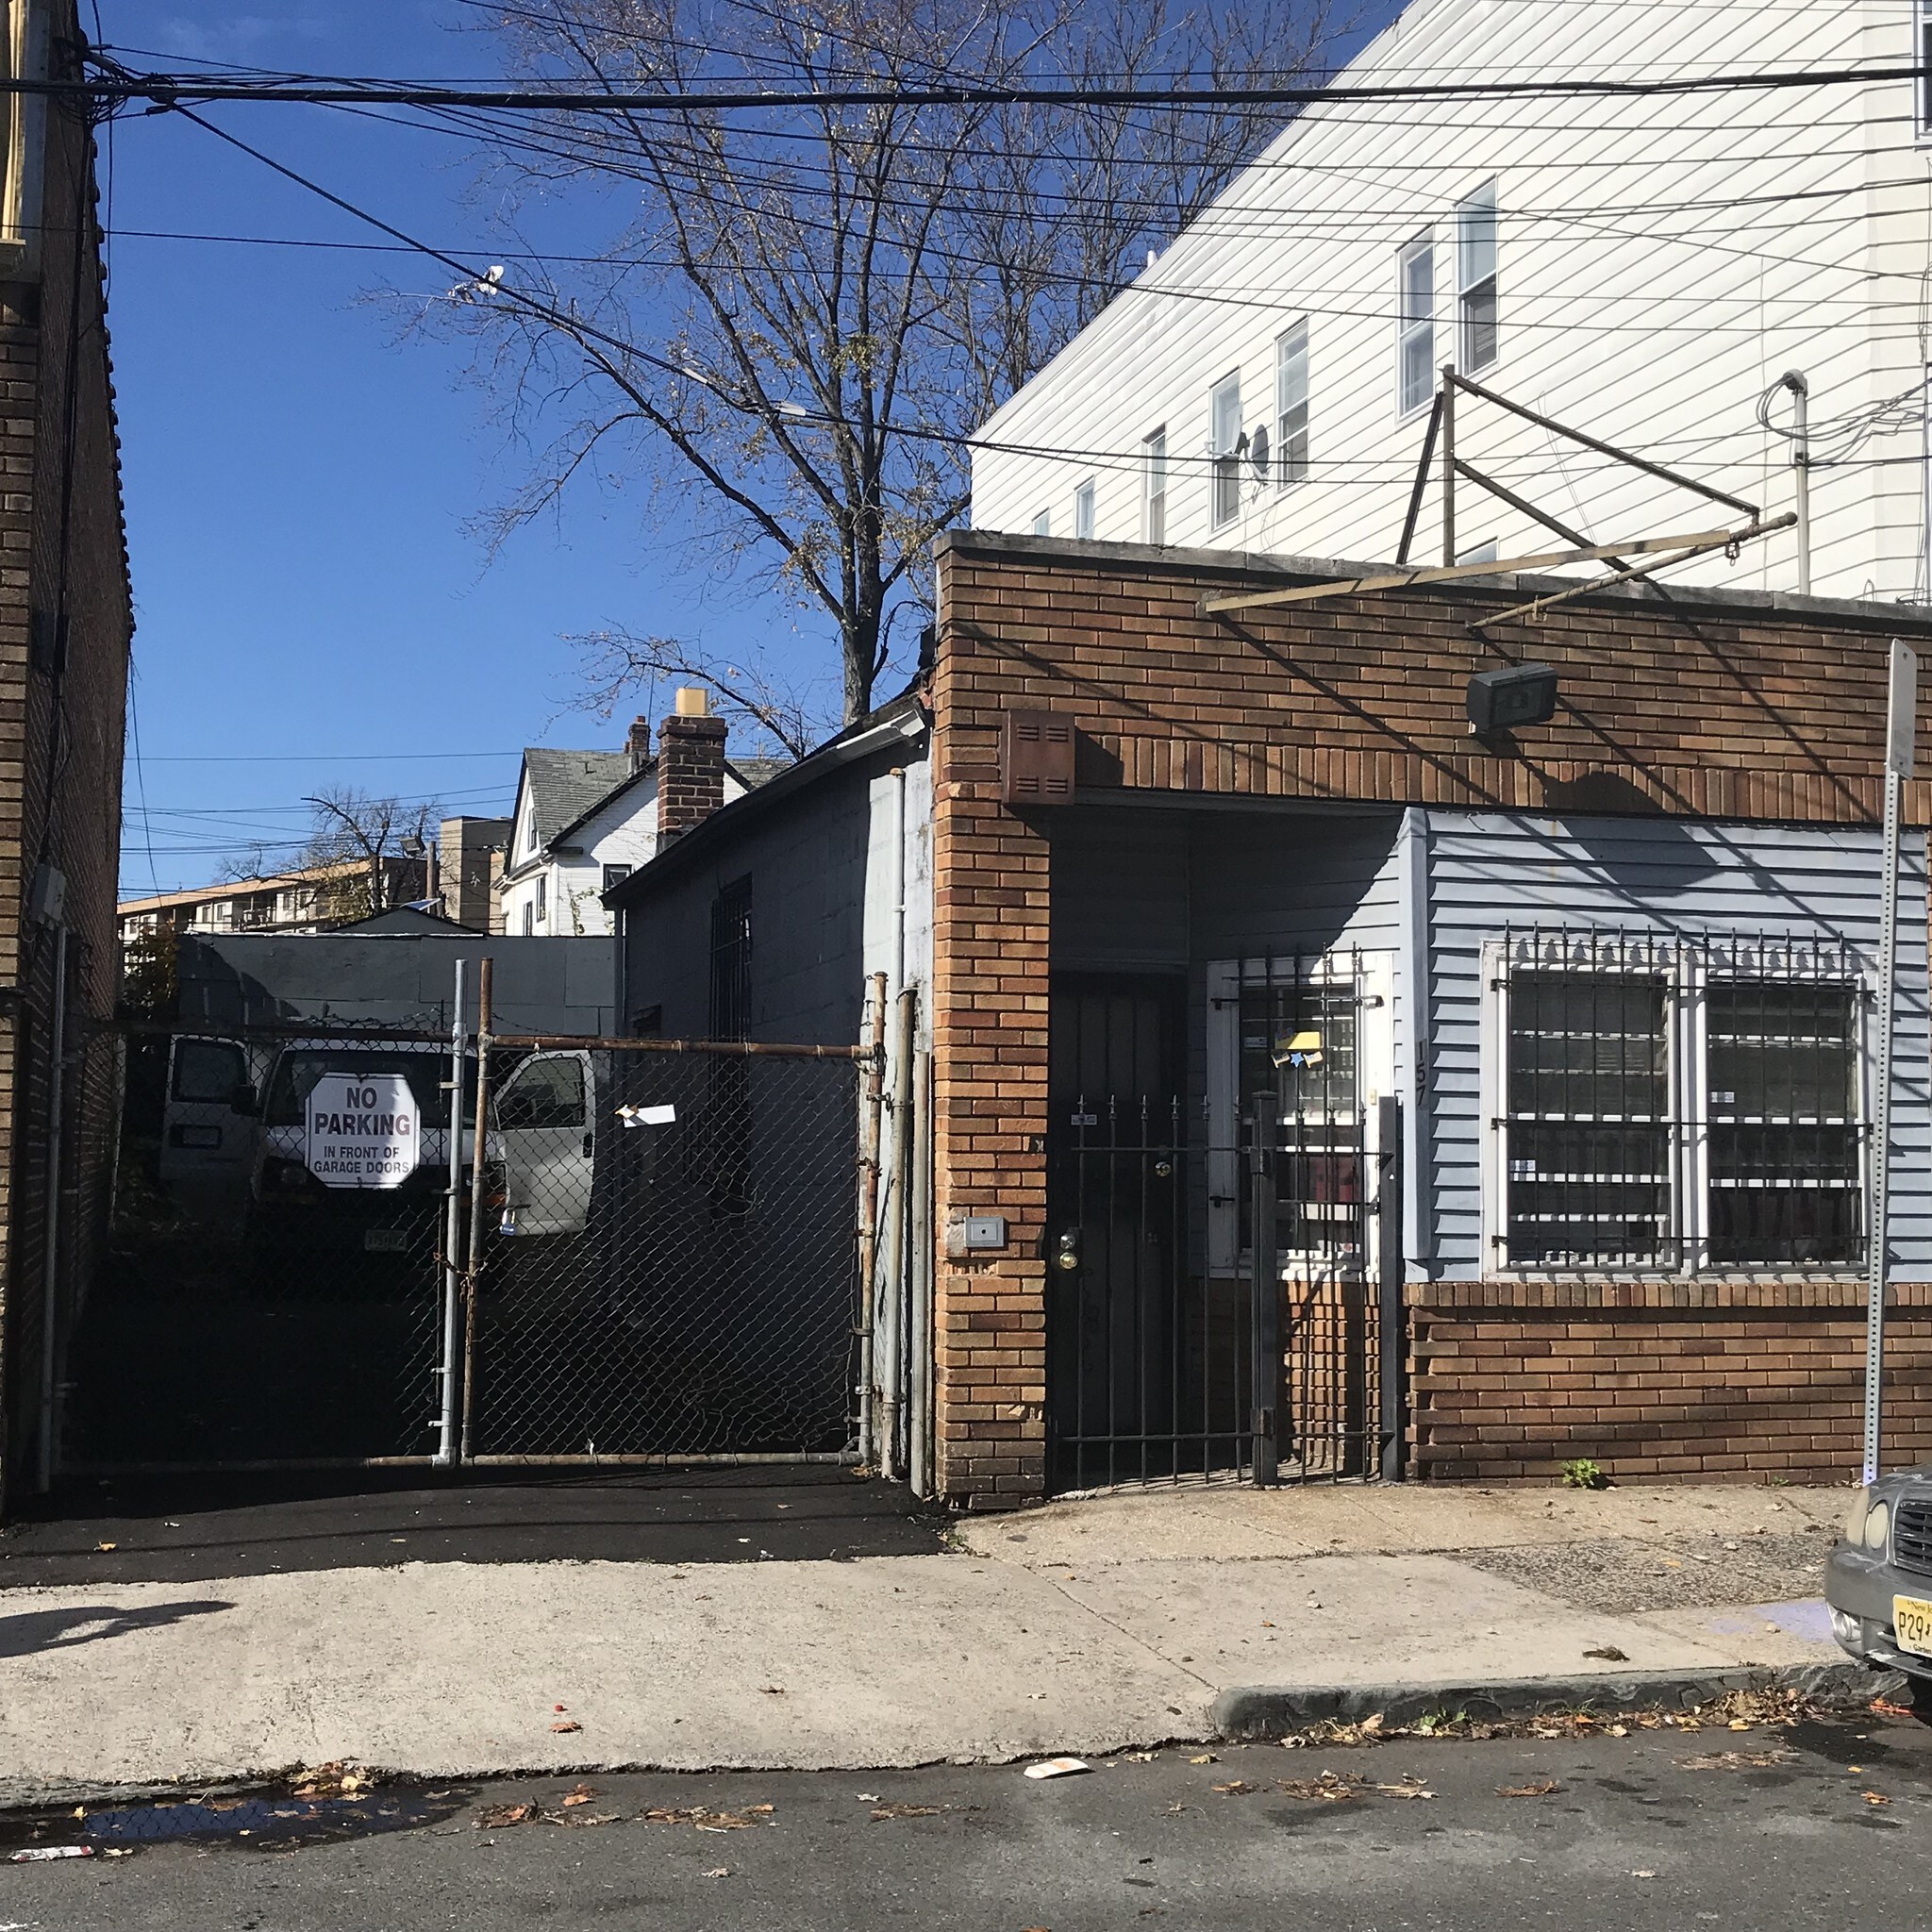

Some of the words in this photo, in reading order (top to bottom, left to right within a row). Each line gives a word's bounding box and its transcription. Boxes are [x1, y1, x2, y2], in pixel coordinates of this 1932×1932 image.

[1416, 1041, 1425, 1107] 157
[346, 1087, 377, 1108] NO
[314, 1113, 410, 1136] PARKING
[324, 1145, 335, 1158] IN
[340, 1146, 378, 1158] FRONT
[383, 1147, 400, 1158] OF
[314, 1160, 361, 1174] GARAGE
[366, 1161, 409, 1174] DOORS
